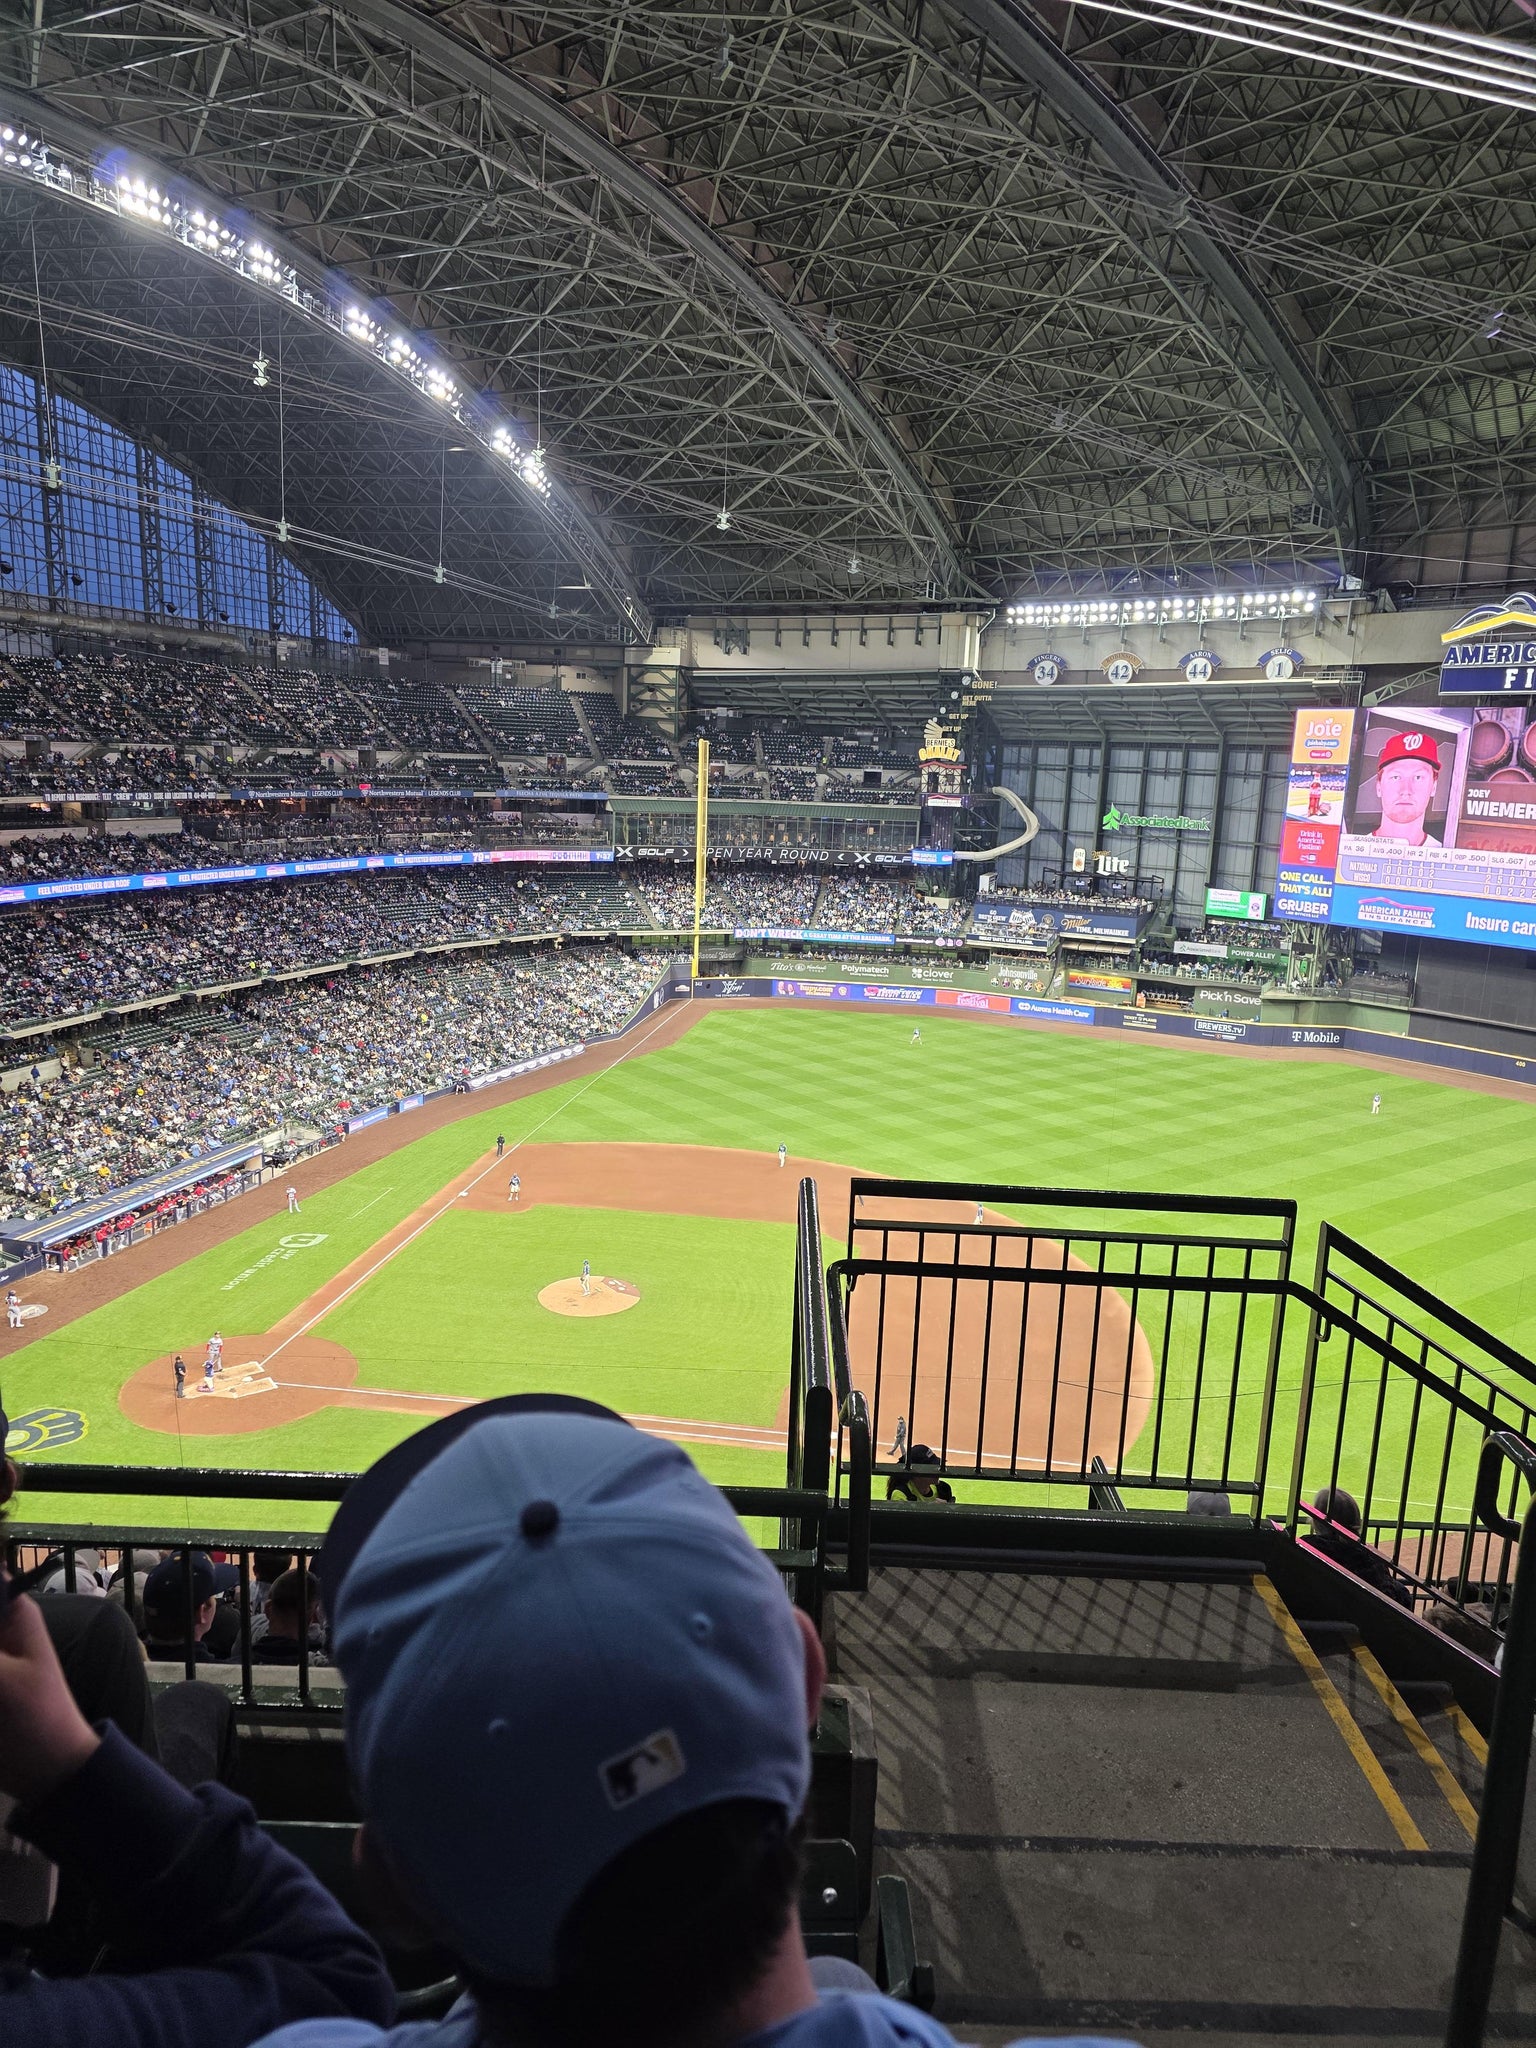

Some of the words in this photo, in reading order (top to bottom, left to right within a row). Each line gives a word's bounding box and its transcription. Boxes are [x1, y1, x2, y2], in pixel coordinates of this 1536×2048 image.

[1189, 651, 1212, 660] AARON
[1270, 648, 1292, 657] SELIG
[1034, 654, 1061, 664] FINGERS
[1037, 665, 1055, 681] 34
[1110, 664, 1130, 680] 42
[1188, 663, 1208, 678] 44
[1275, 662, 1283, 678] 1
[972, 680, 998, 689] GONE!
[1306, 717, 1343, 737] Joie
[1467, 788, 1491, 798] JOEY
[1466, 800, 1536, 820] WIEMER
[1354, 836, 1376, 844] SEASON
[638, 848, 674, 857] GOLF
[738, 848, 772, 859] YEAR
[779, 849, 829, 861] ROUND
[874, 855, 912, 864] GOLF
[1096, 855, 1130, 876] Lite
[1349, 861, 1378, 873] NATIONALS
[178, 874, 190, 882] FEEL
[1280, 871, 1302, 881] ONE
[38, 886, 51, 896] FEEL
[51, 883, 83, 894] PROTECTED
[83, 881, 103, 891] UNDER
[103, 880, 115, 889] OUR
[116, 879, 131, 888] ROOF
[1279, 882, 1311, 895] THAT'S
[1311, 886, 1333, 898] ALL!
[1277, 898, 1329, 915] GRUBER
[1359, 904, 1401, 917] AMERICAN
[1402, 908, 1433, 920] FAMILY
[1061, 918, 1093, 931] Miller
[1364, 914, 1426, 925] INSURANCE
[1465, 911, 1510, 933] Insure
[734, 928, 768, 938] DON'T
[768, 929, 803, 939] WRECK
[1093, 927, 1129, 937] MILWAUKEE
[1231, 949, 1254, 958] POWER
[1254, 951, 1276, 960] ALLEY
[770, 962, 794, 972] Tito's
[841, 964, 889, 974] Polymatech
[922, 967, 954, 979] clover
[998, 966, 1038, 980] Johnsonville
[1075, 976, 1107, 987] Surfside
[1199, 990, 1232, 1002] Pick'n
[1233, 994, 1261, 1006] Save
[1030, 1004, 1052, 1014] Aurora
[1052, 1007, 1073, 1017] Health
[1073, 1010, 1090, 1018] Care
[1303, 1031, 1340, 1043] Mobile
[70, 1201, 112, 1217] FIELD
[252, 1247, 285, 1268] credit
[220, 1268, 259, 1291] union
